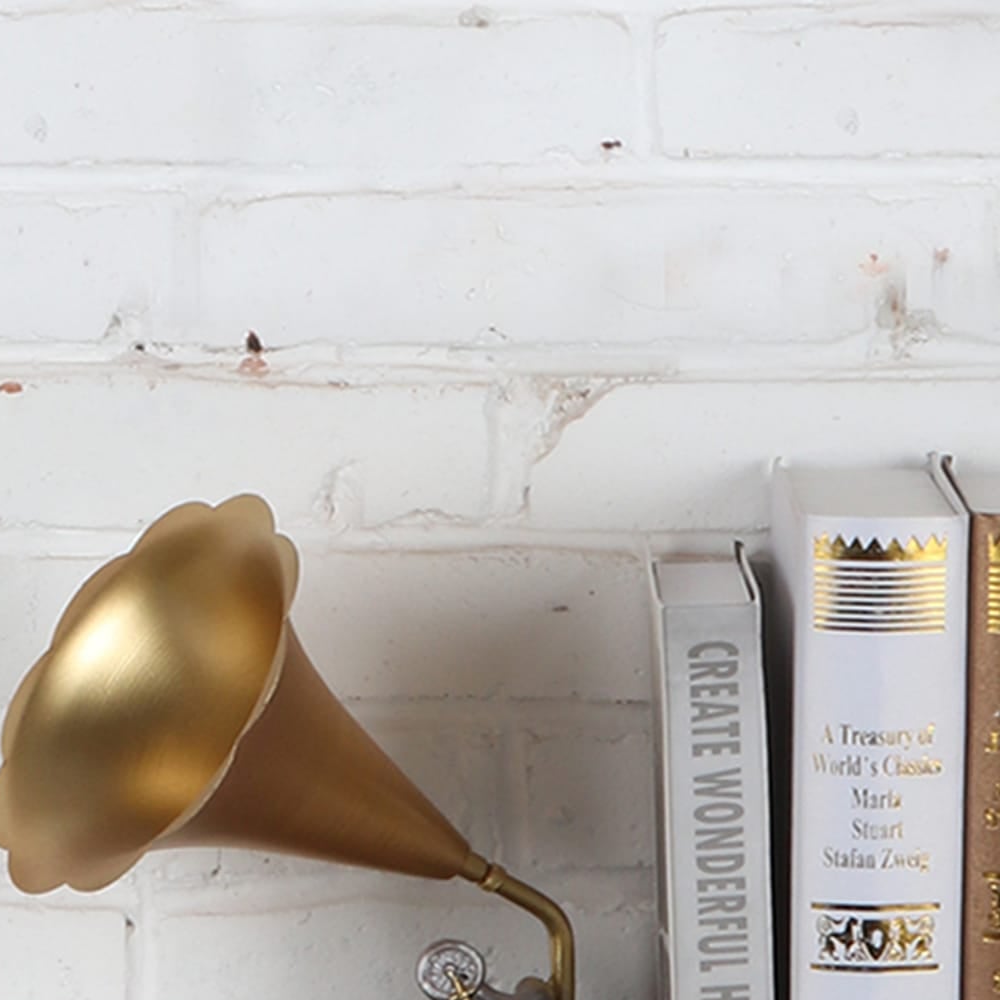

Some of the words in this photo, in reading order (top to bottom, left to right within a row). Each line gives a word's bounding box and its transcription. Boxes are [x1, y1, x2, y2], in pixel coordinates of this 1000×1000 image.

[688, 640, 741, 757] CREATE
[822, 724, 834, 745] A
[840, 723, 913, 750] Treasury
[812, 754, 878, 777] World's
[852, 786, 902, 809] Maria
[852, 819, 903, 840] Stuart
[693, 768, 749, 973] WONDERFUL
